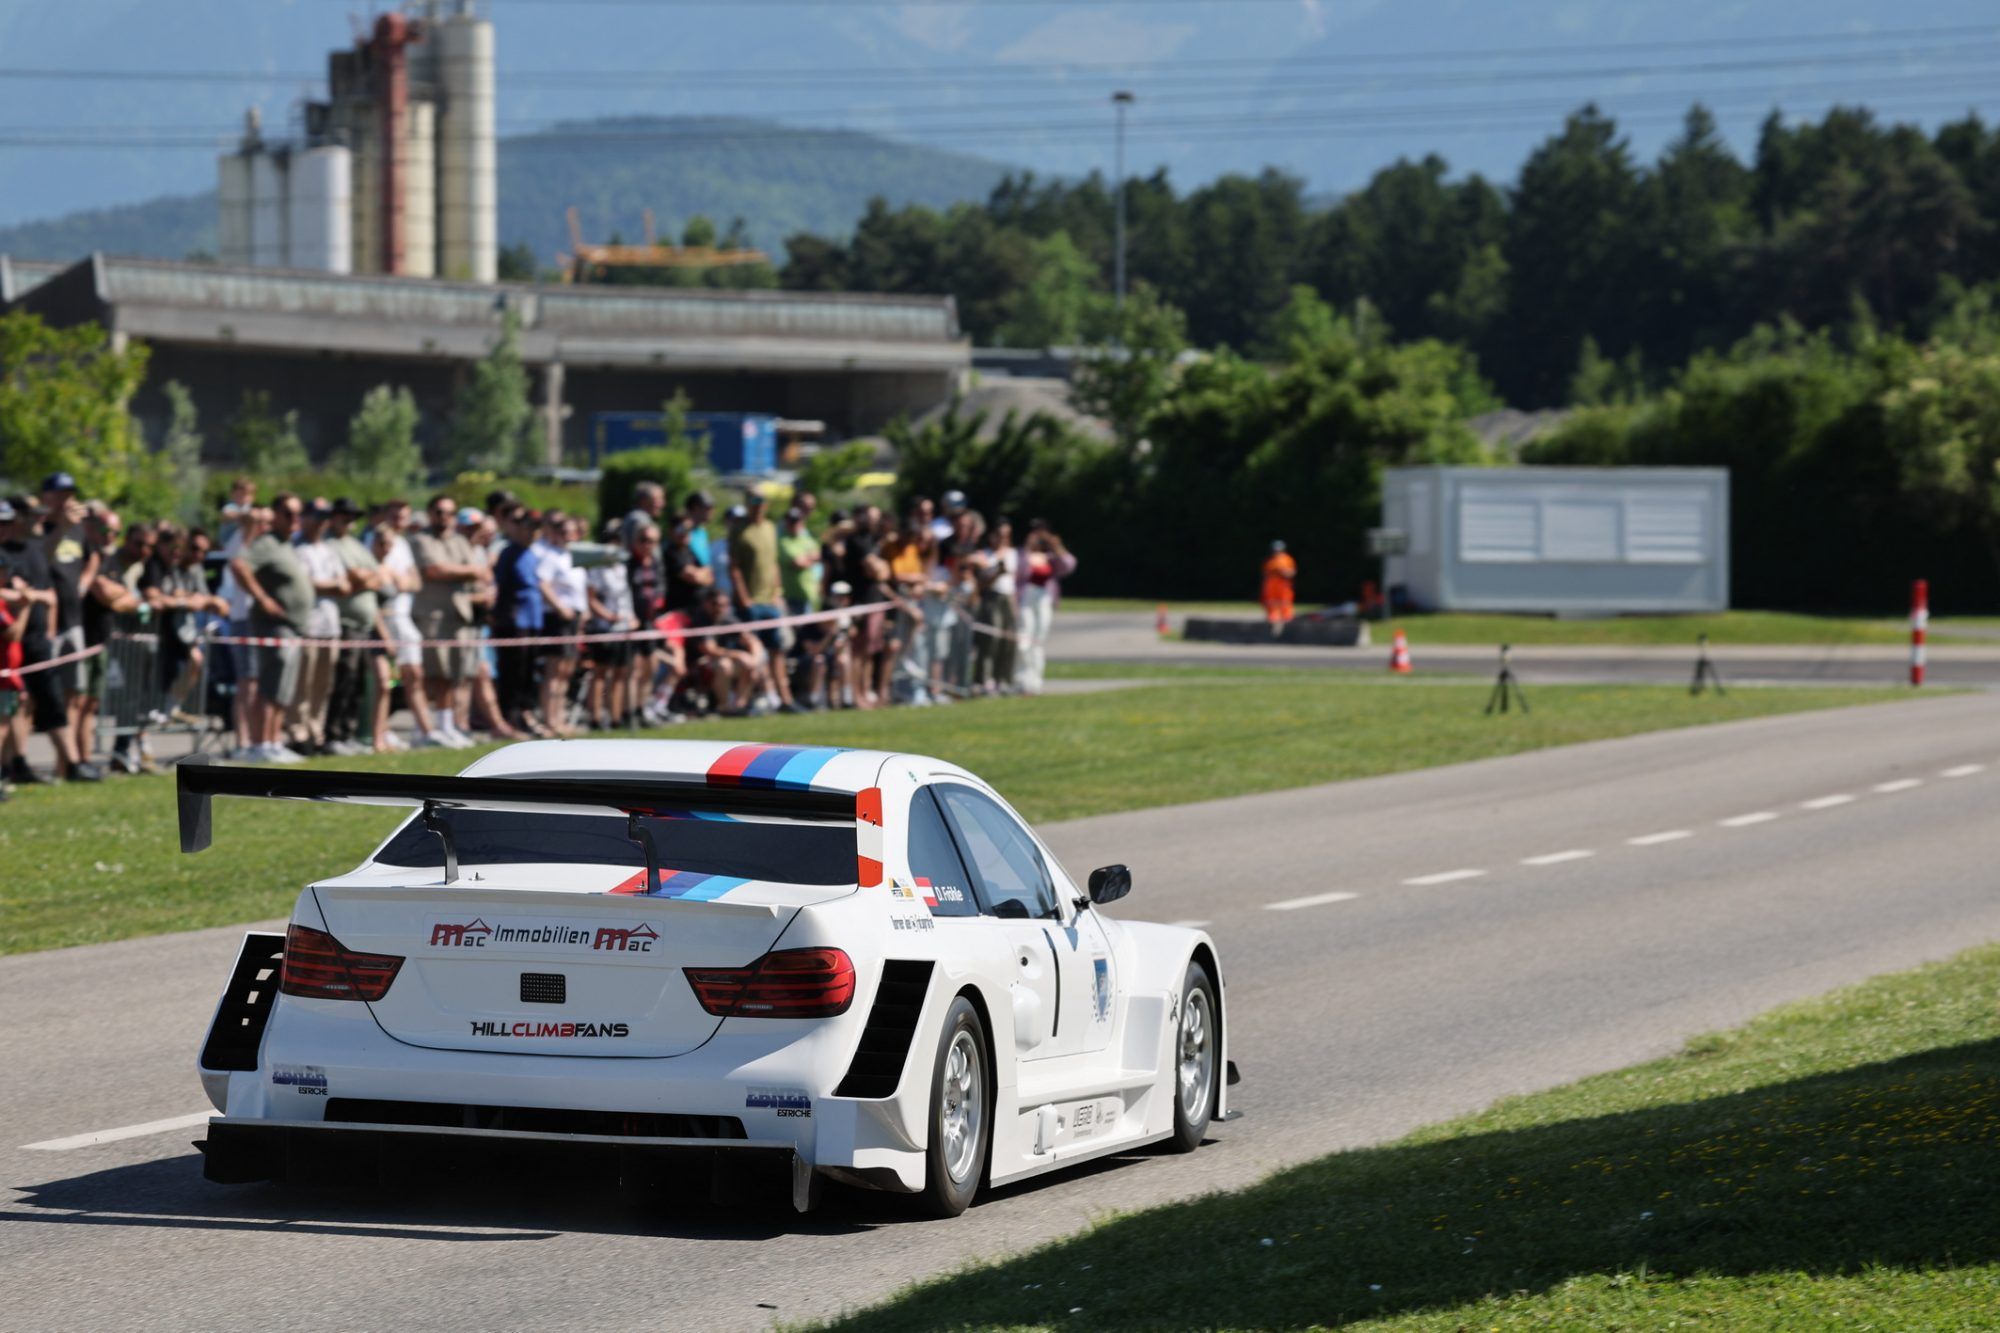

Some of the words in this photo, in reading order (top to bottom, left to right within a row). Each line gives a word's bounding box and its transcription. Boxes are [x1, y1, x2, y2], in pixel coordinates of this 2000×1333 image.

[495, 923, 589, 945] Immobilien
[471, 1021, 628, 1037] HILLCLIMBFANS
[298, 1086, 328, 1095] ESTRICHE
[777, 1109, 811, 1118] ESTRICHE
